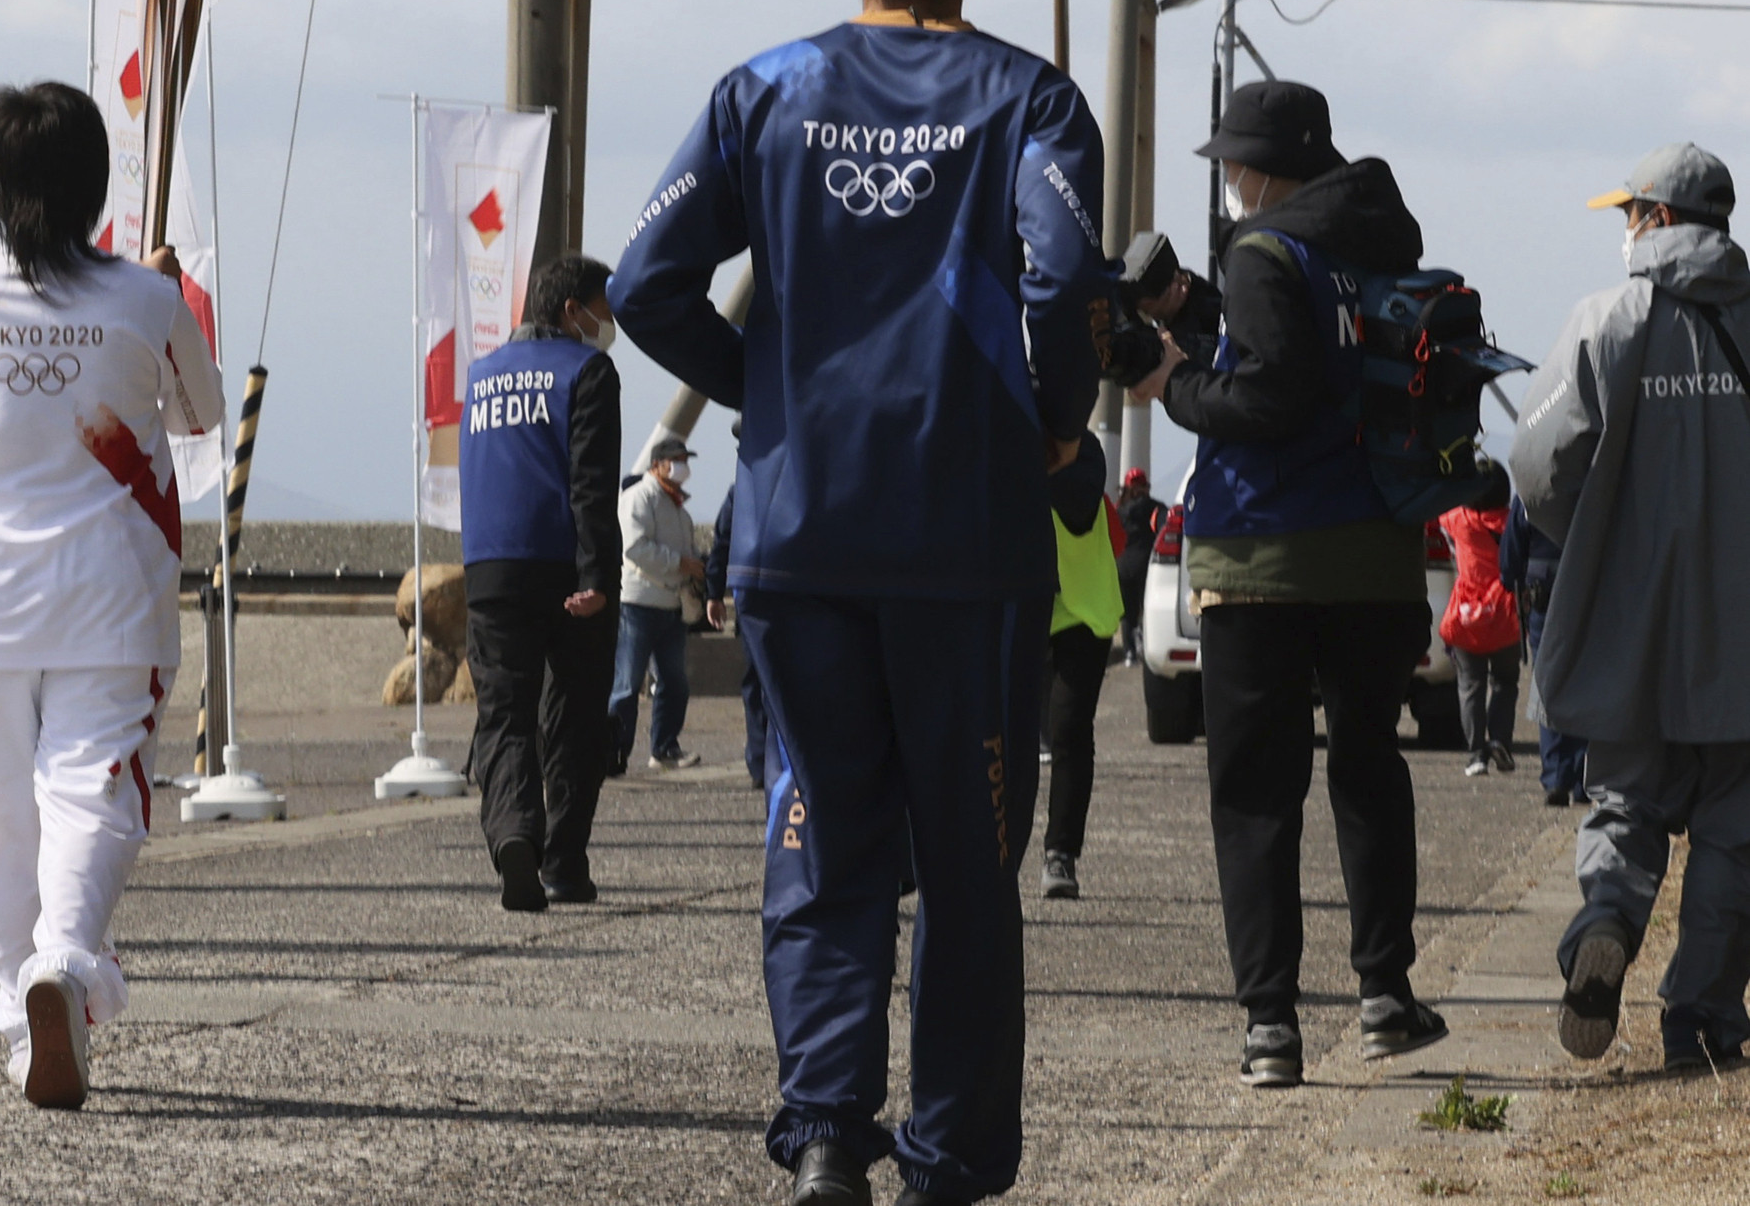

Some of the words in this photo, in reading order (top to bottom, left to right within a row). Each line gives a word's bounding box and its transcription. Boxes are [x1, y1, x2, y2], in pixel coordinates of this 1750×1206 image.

[803, 120, 897, 156] TOKYO
[900, 123, 967, 155] 2020
[659, 171, 697, 208] 2020
[1043, 160, 1081, 210] TOKYO
[1073, 207, 1099, 249] 2020
[48, 323, 104, 347] 2020
[472, 373, 514, 402] TOKYO
[515, 370, 554, 391] 2020
[470, 392, 551, 435] MEDIA
[783, 788, 806, 851] PO
[983, 735, 1009, 868] POLICE
